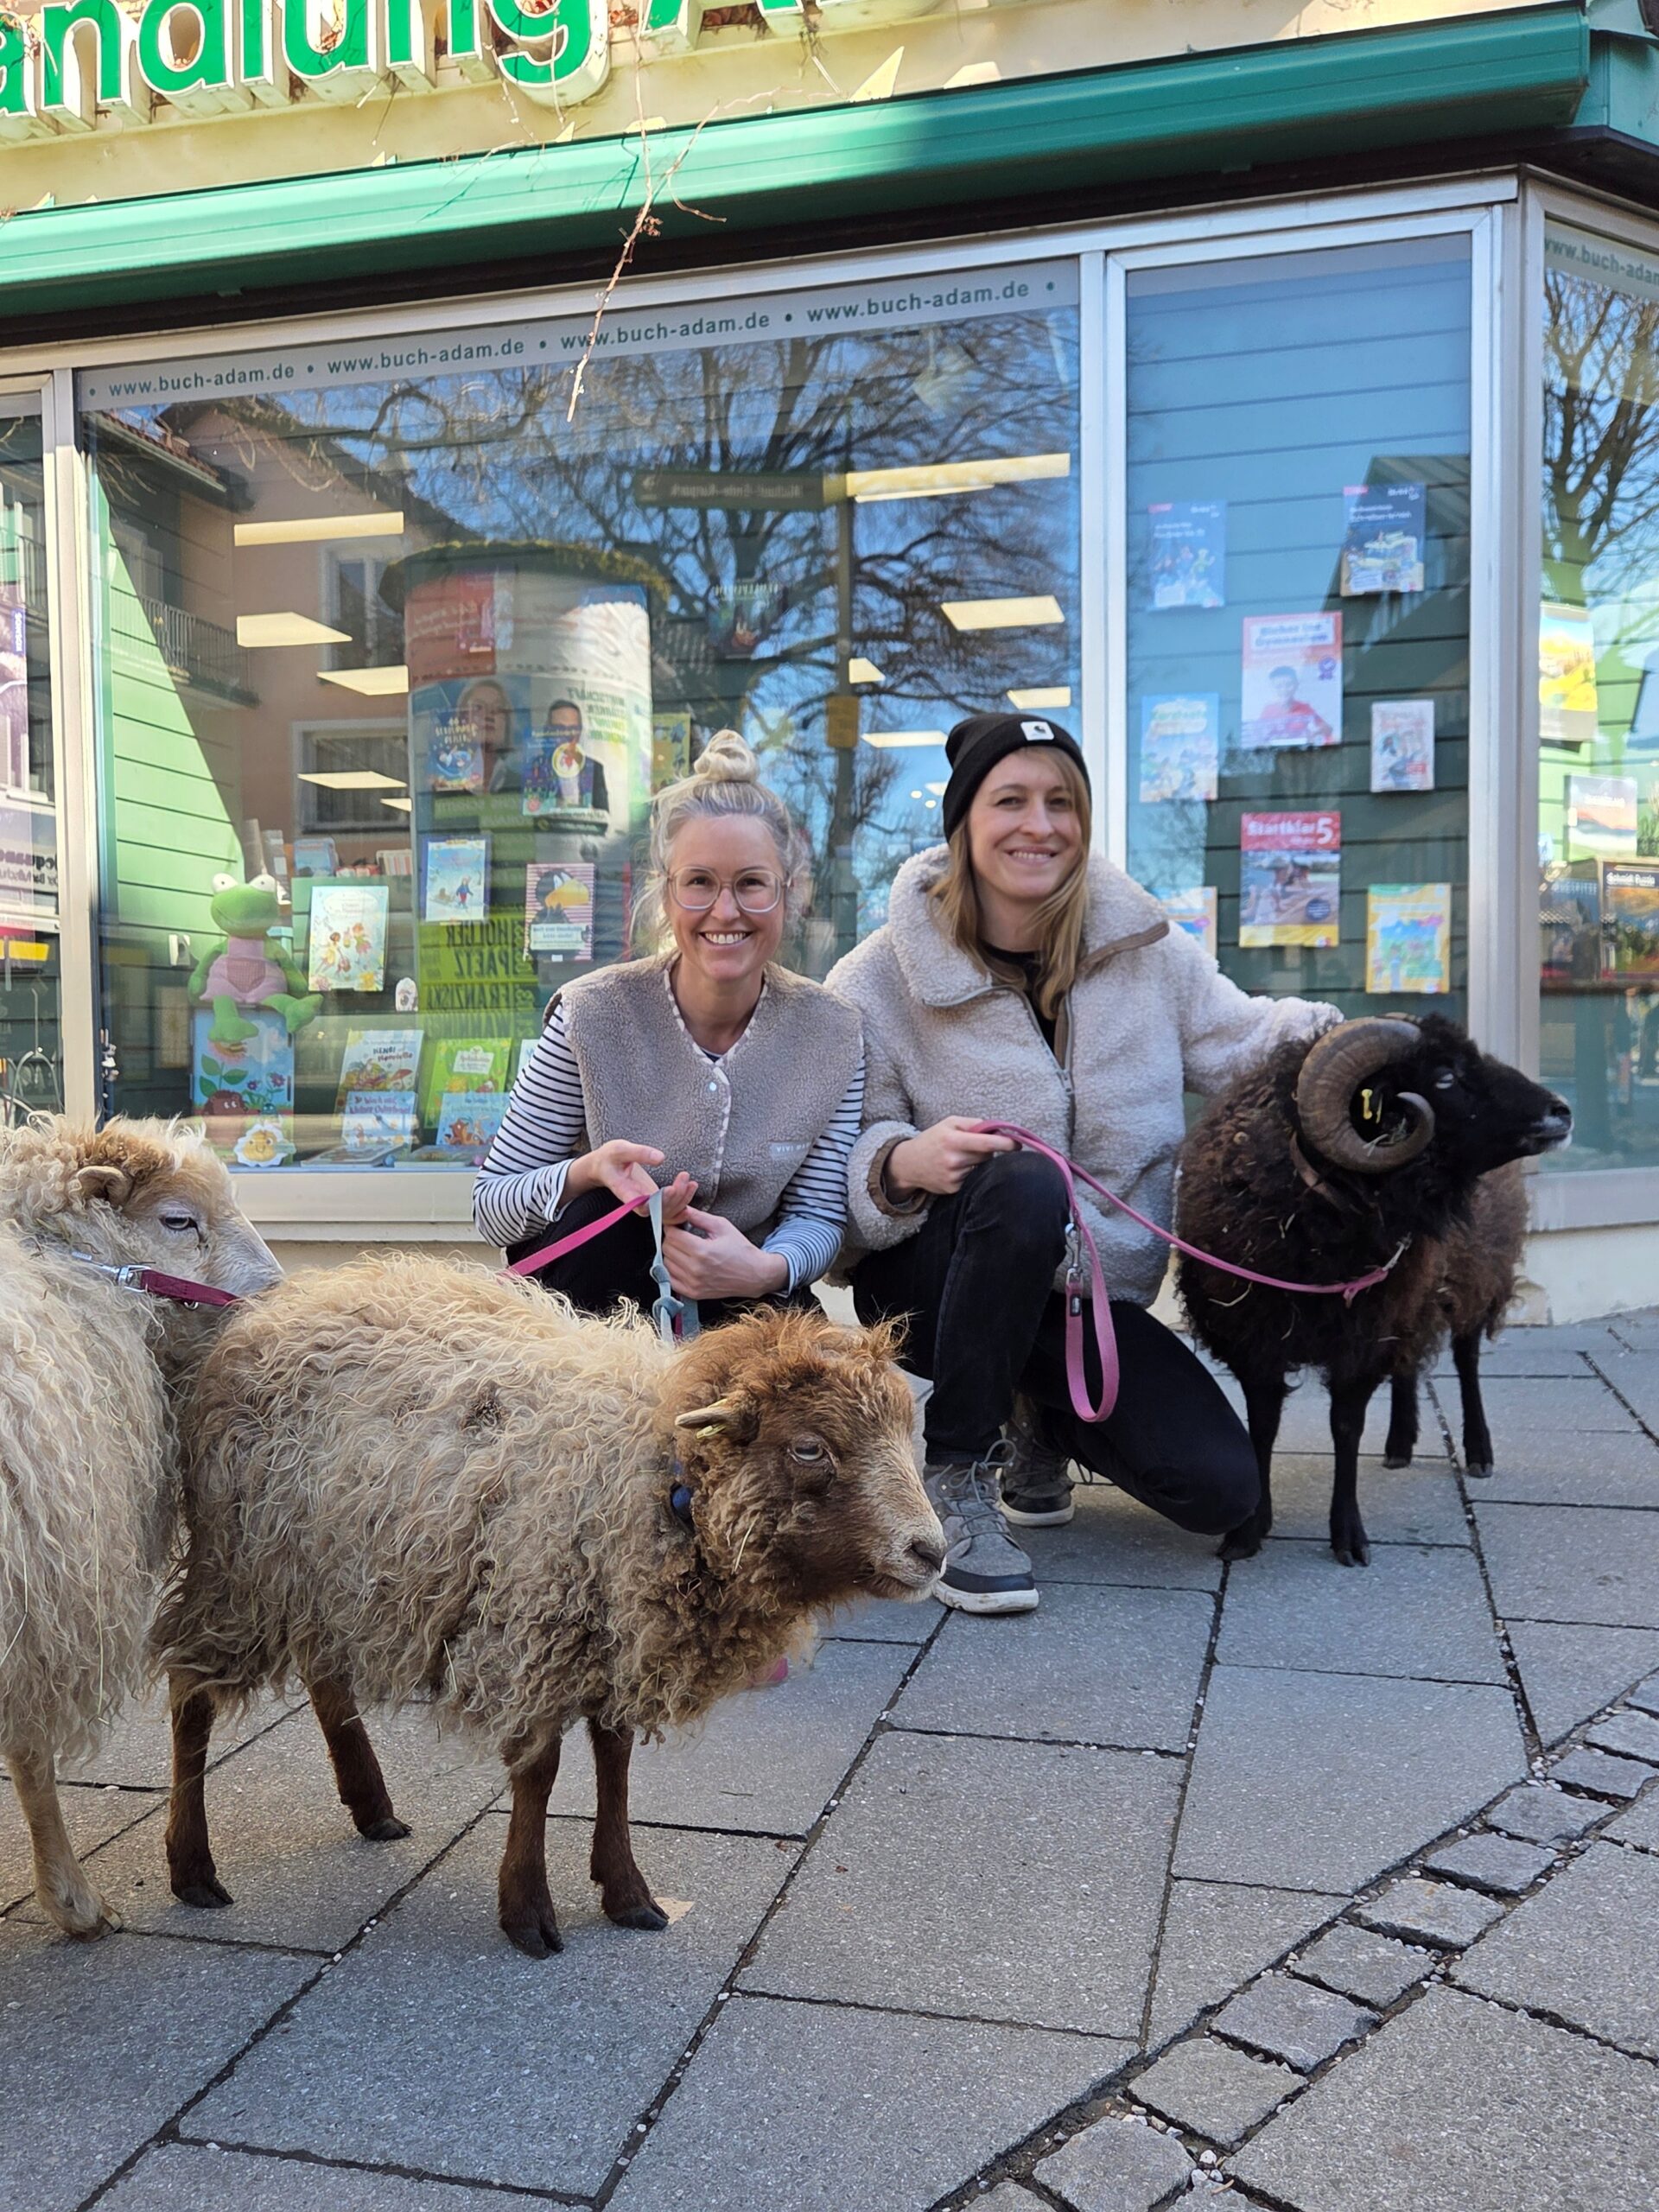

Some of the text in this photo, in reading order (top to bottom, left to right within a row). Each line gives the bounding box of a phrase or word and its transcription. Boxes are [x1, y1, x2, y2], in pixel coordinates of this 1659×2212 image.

[807, 281, 1029, 322] www.buch-adam.de
[561, 312, 770, 349] www.buch-adam.de
[327, 338, 524, 373] www.buch-adam.de
[109, 363, 295, 397] www.buch-adam.de
[1316, 817, 1333, 844] 5
